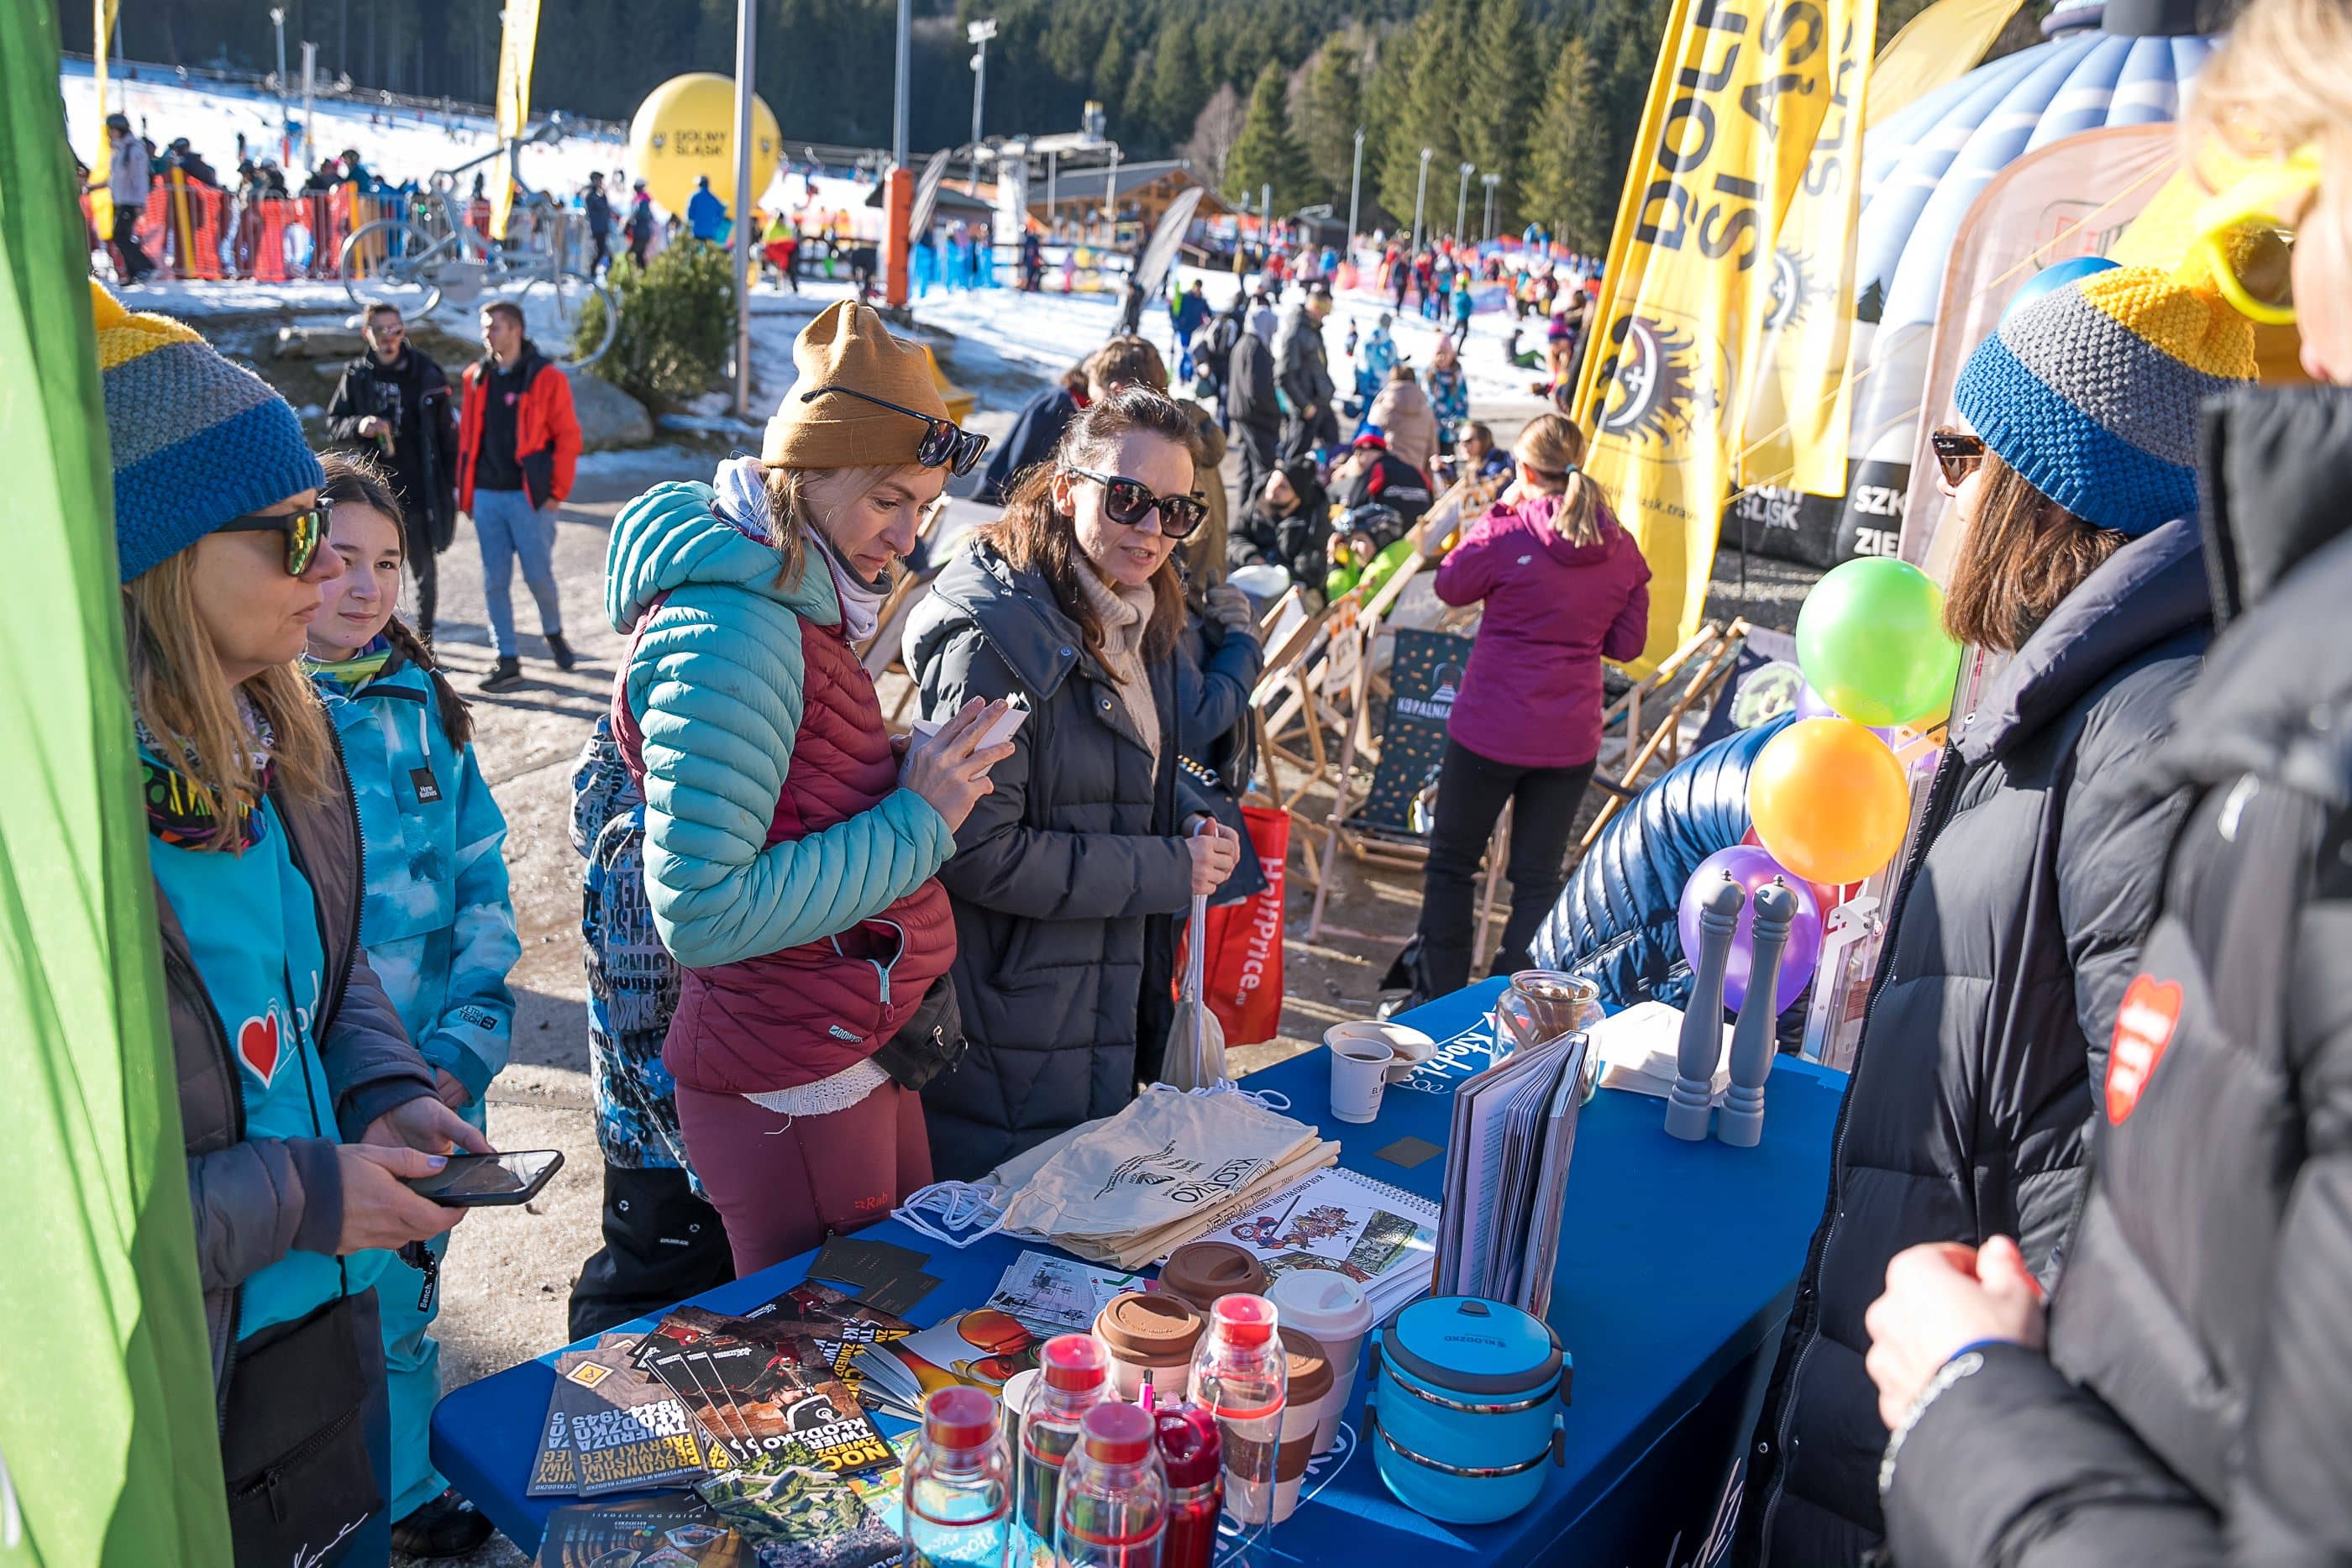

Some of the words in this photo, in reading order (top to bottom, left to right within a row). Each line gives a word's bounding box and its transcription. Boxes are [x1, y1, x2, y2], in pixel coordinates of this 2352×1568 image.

[420, 1282, 433, 1308] Bench.
[571, 1398, 680, 1429] 1944-1945
[574, 1408, 686, 1440] KŁODZKO
[576, 1420, 690, 1451] TWIERDZA
[617, 1433, 695, 1457] FABRYKI
[762, 1417, 868, 1450] KŁODZKO
[580, 1449, 615, 1466] AEG
[581, 1445, 697, 1475] PRZYMUSOWI
[583, 1454, 701, 1484] PRACOWNICY
